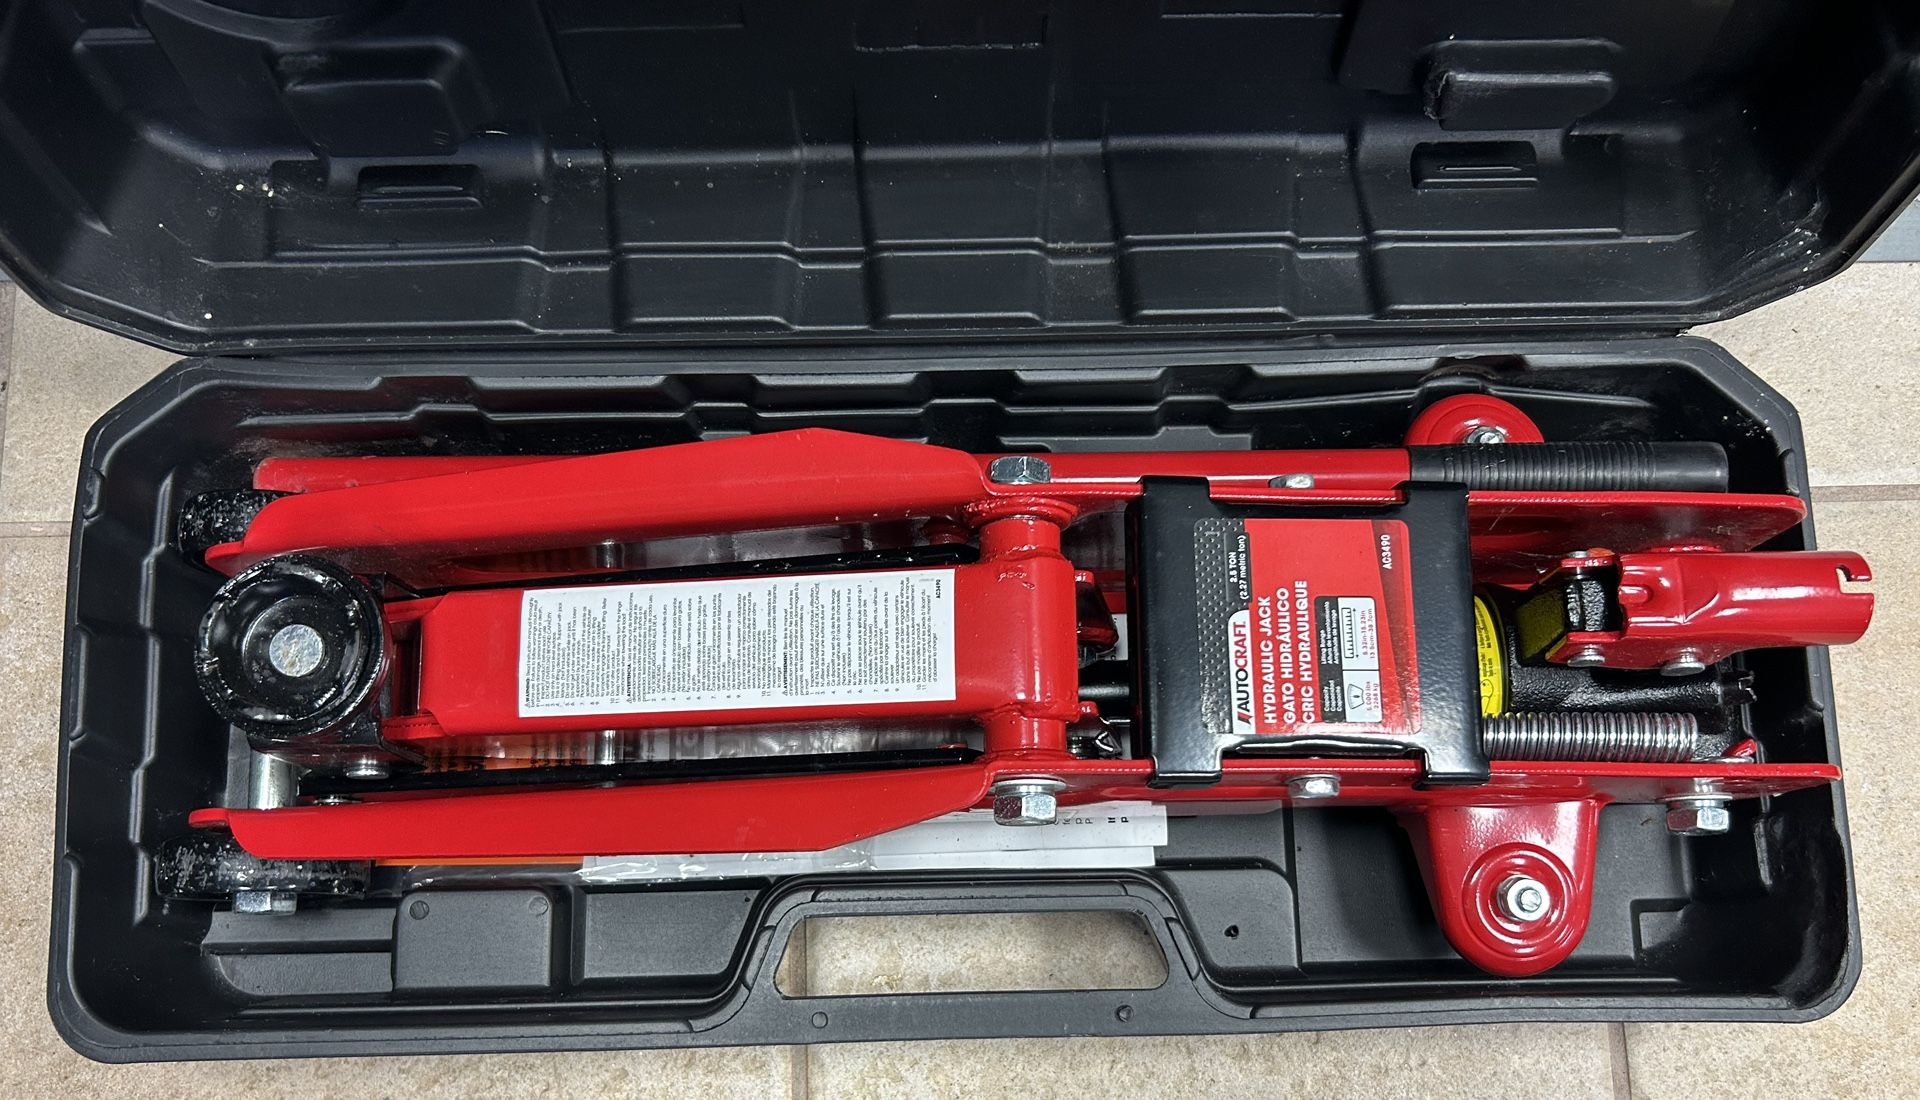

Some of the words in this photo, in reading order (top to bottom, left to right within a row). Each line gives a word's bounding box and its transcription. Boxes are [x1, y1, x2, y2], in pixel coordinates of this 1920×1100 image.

[1229, 552, 1237, 568] TON
[1237, 536, 1247, 552] ton)
[1381, 535, 1393, 569] AC3490
[1238, 554, 1247, 578] metric
[1239, 580, 1248, 600] (2.27
[1258, 596, 1271, 636] JACK
[1275, 588, 1293, 678] HIDRÁULICO
[1295, 581, 1312, 681] HYDRAULIQUE
[1233, 622, 1250, 712] AUTOCRAFT
[1260, 641, 1276, 723] HYDRAULIC
[1282, 684, 1296, 723] GATO
[1301, 686, 1315, 722] CRIC
